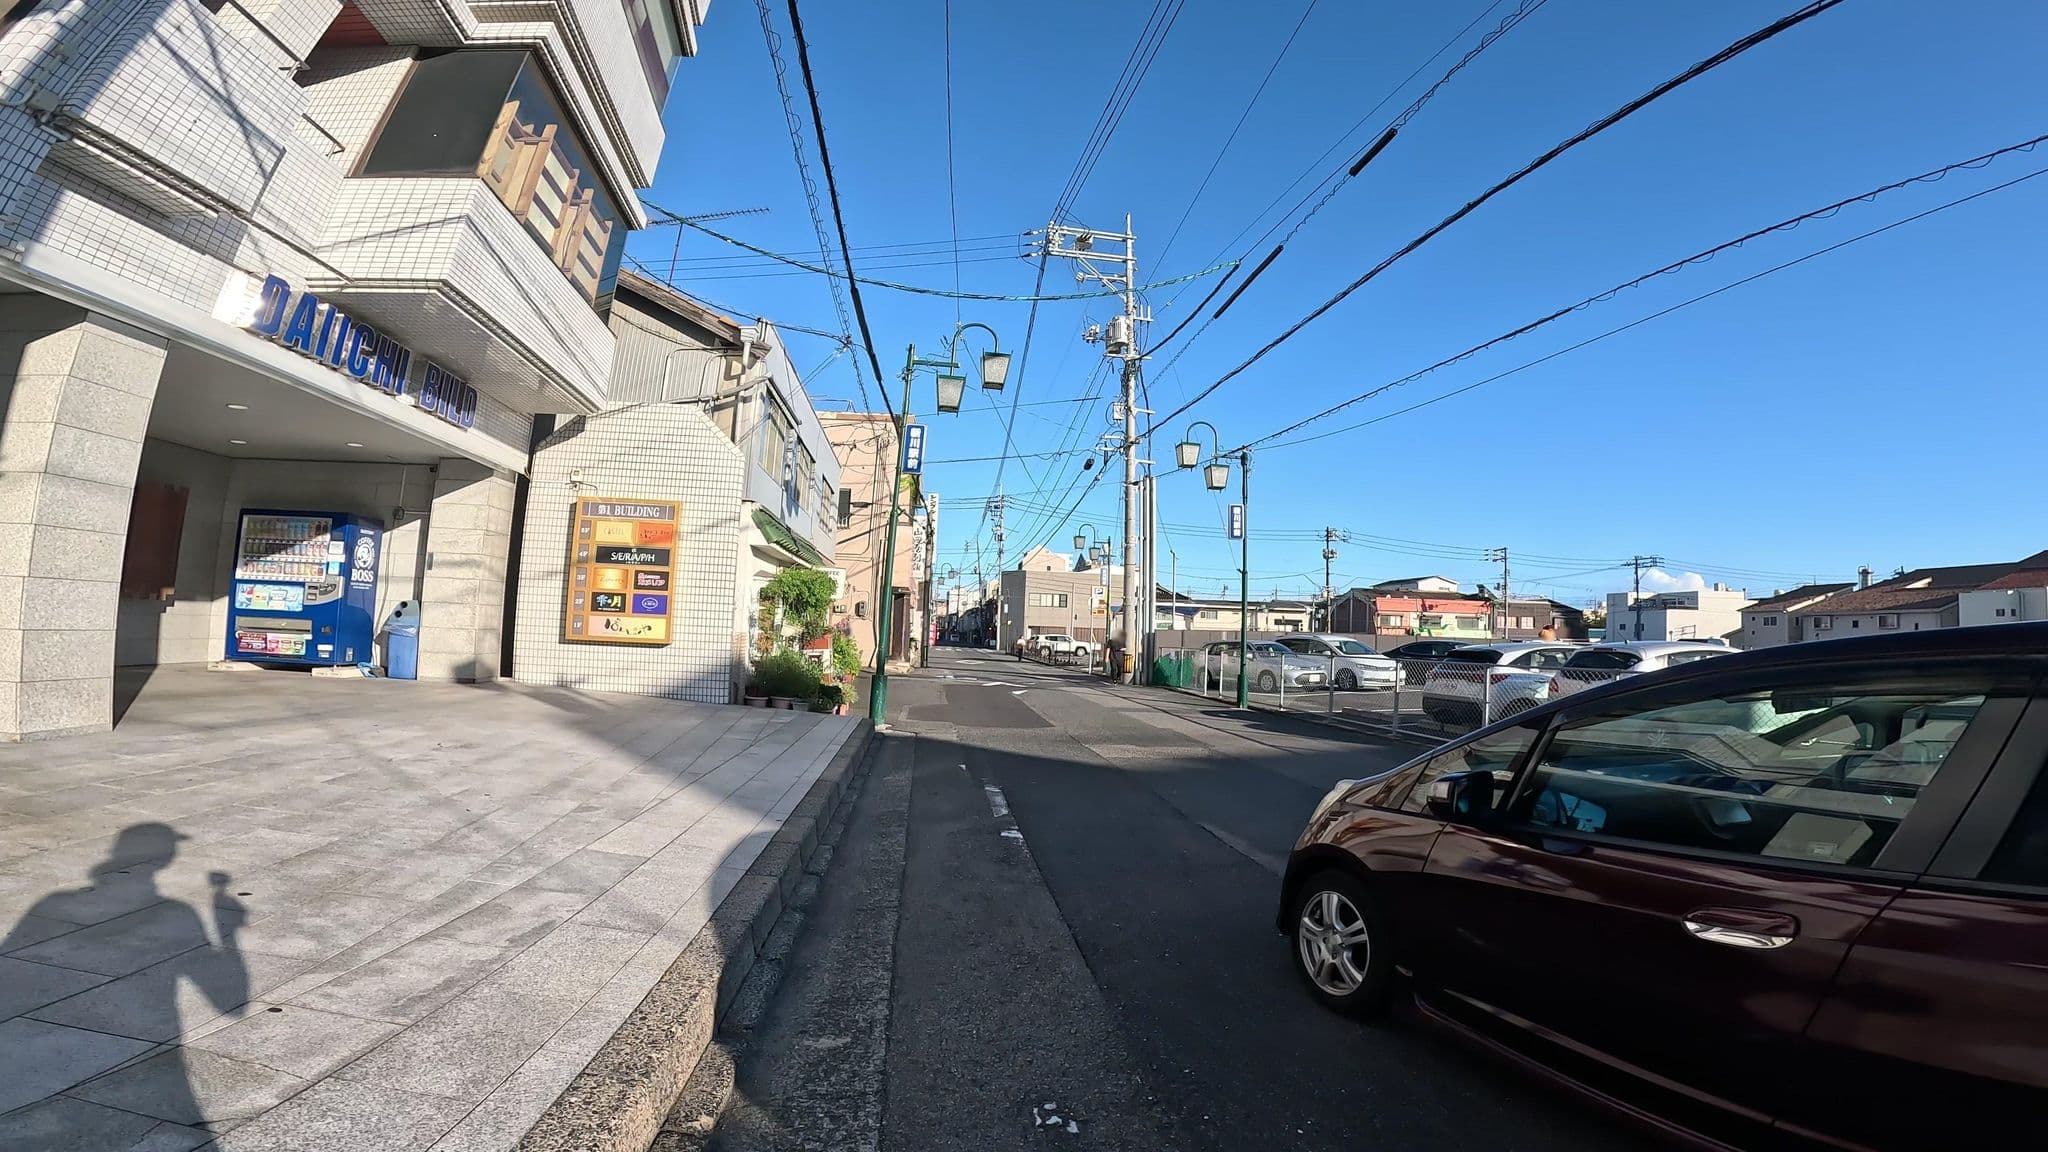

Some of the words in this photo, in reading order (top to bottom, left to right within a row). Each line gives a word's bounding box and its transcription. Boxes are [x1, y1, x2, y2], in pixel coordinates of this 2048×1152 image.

[254, 274, 412, 395] DAIICHI
[419, 361, 478, 429] BILD
[614, 505, 659, 517] BUILDING
[357, 536, 375, 547] COFFEE
[351, 568, 374, 582] BOSS
